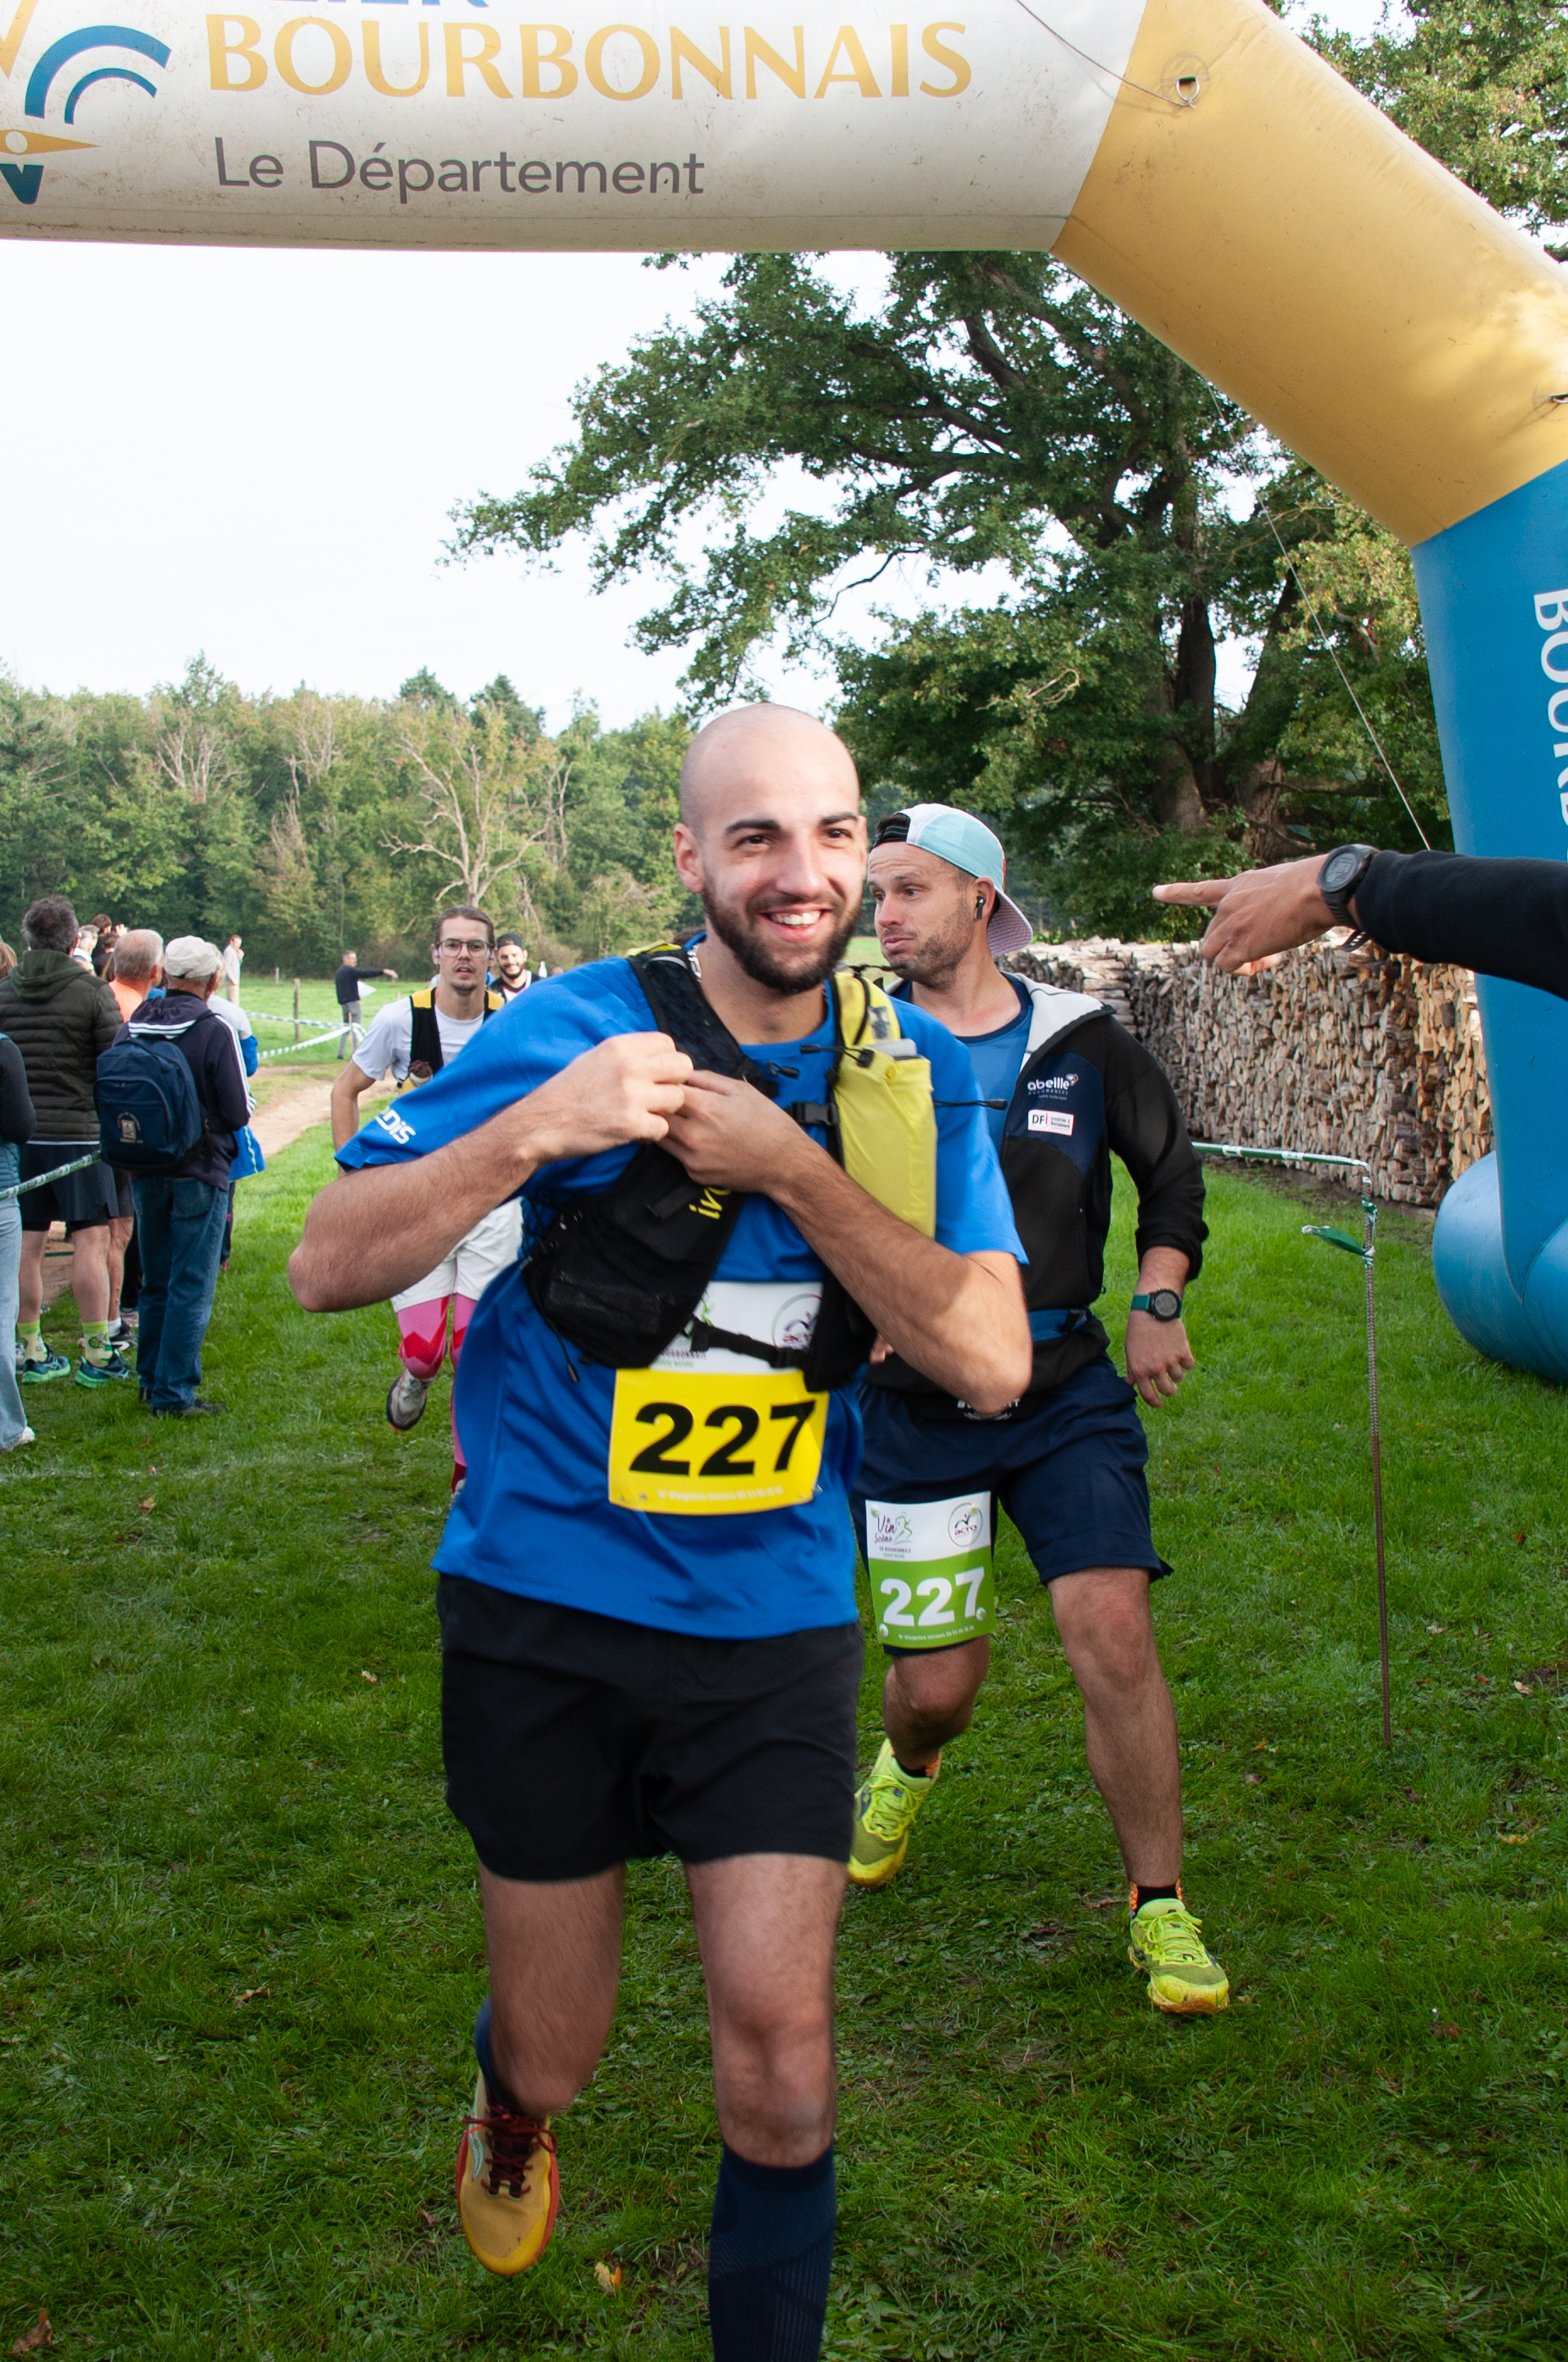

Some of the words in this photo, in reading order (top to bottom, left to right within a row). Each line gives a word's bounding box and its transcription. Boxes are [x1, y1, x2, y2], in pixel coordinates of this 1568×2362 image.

[206, 14, 972, 101] BOURBONNAIS
[214, 137, 285, 188] Le
[309, 139, 706, 205] Département
[629, 1399, 816, 1477] 227
[880, 1567, 985, 1627] 227
